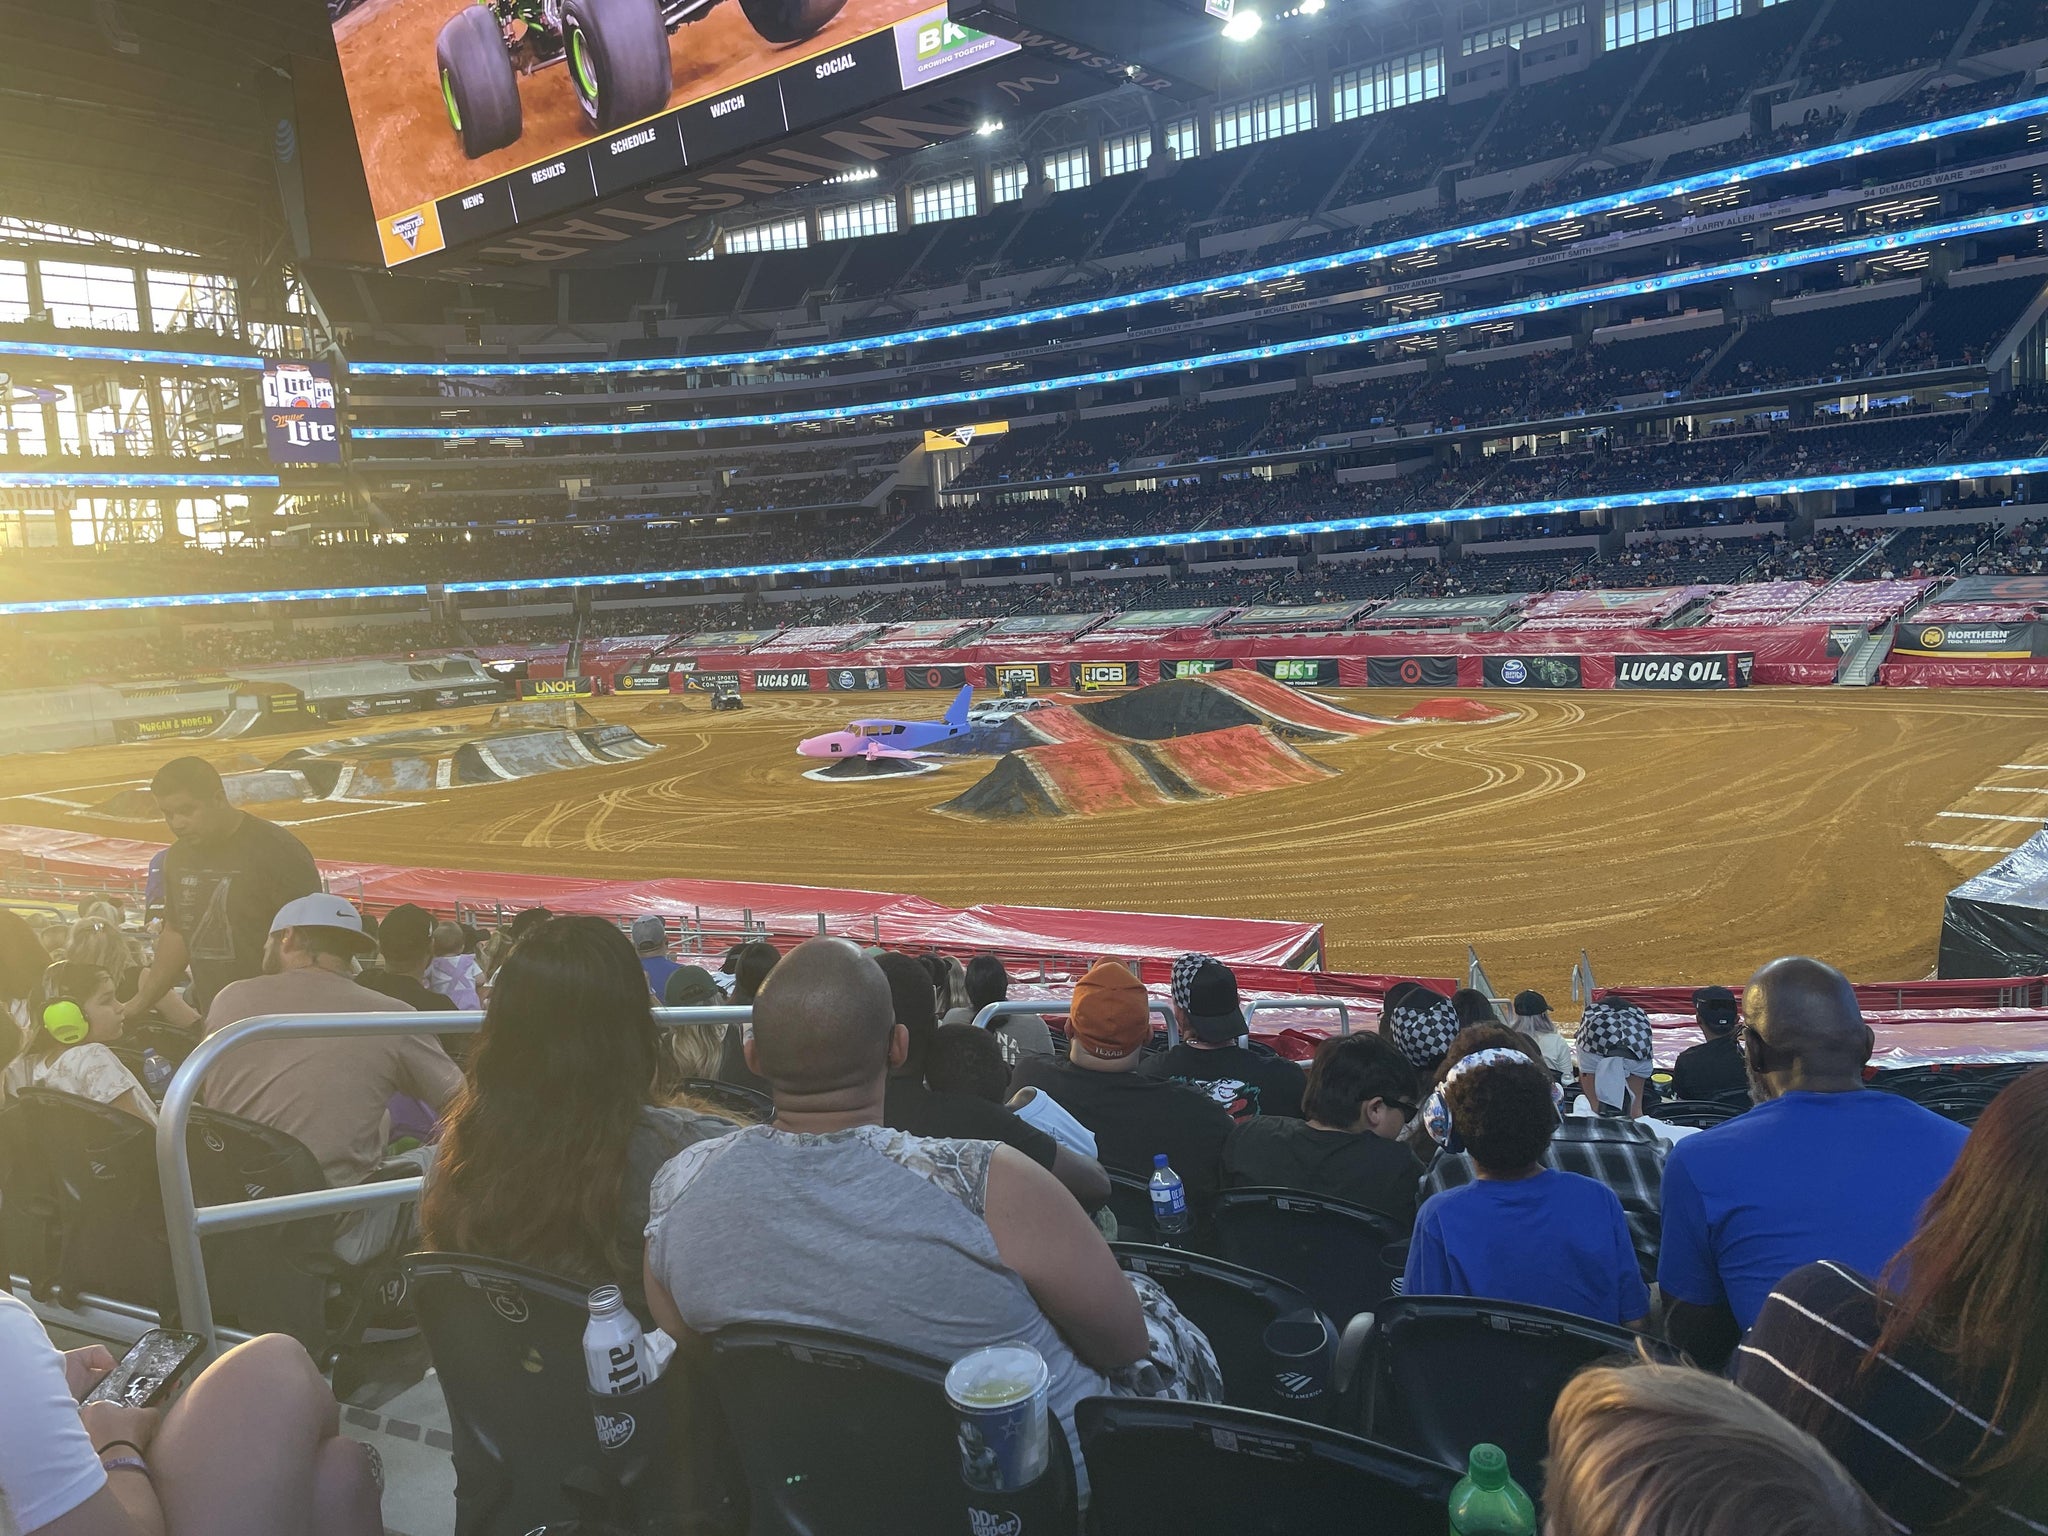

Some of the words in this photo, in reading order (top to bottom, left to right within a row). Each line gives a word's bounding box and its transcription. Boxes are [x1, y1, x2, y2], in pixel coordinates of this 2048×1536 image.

[918, 21, 968, 55] BK
[917, 55, 953, 72] GROWING
[954, 40, 996, 59] TOGETHER
[1011, 30, 1172, 91] WINSTAR
[815, 53, 857, 80] SOCIAL
[710, 94, 745, 119] WATCH
[610, 128, 656, 155] SCHEDULE
[531, 162, 567, 184] RESULTS
[1863, 189, 1876, 198] 94
[1934, 170, 1963, 184] WARE
[462, 192, 485, 210] NEWS
[391, 217, 425, 236] MONSTER
[1682, 224, 1694, 235] 73
[1696, 220, 1725, 232] LARRY
[1726, 213, 1755, 226] ALLEN
[1527, 258, 1536, 266] 22
[1537, 252, 1566, 264] EMMITT
[1568, 247, 1592, 258] SMITH
[1393, 280, 1411, 292] TROY
[1411, 277, 1437, 289] AIKMAN
[1263, 305, 1290, 316] MICHAEL
[1291, 302, 1307, 311] IRVIN
[1135, 327, 1162, 338] CHARLES
[1162, 324, 1182, 334] HALEY
[284, 378, 312, 395] Lite
[286, 420, 337, 447] Lite
[1947, 630, 2008, 640] NORTHERN
[1000, 669, 1036, 682] JCB
[1085, 667, 1123, 681] JCB
[1177, 661, 1215, 676] BKT
[1276, 662, 1317, 676] BKT
[1619, 662, 1684, 682] LUCAS
[535, 680, 576, 693] UNOH
[757, 674, 789, 687] LUCAS
[139, 720, 172, 732] MORGAN
[174, 719, 180, 729] &
[181, 715, 213, 728] MORGAN
[608, 1343, 647, 1394] ite
[1295, 1388, 1323, 1400] AMERICA
[980, 1509, 999, 1525] Dr
